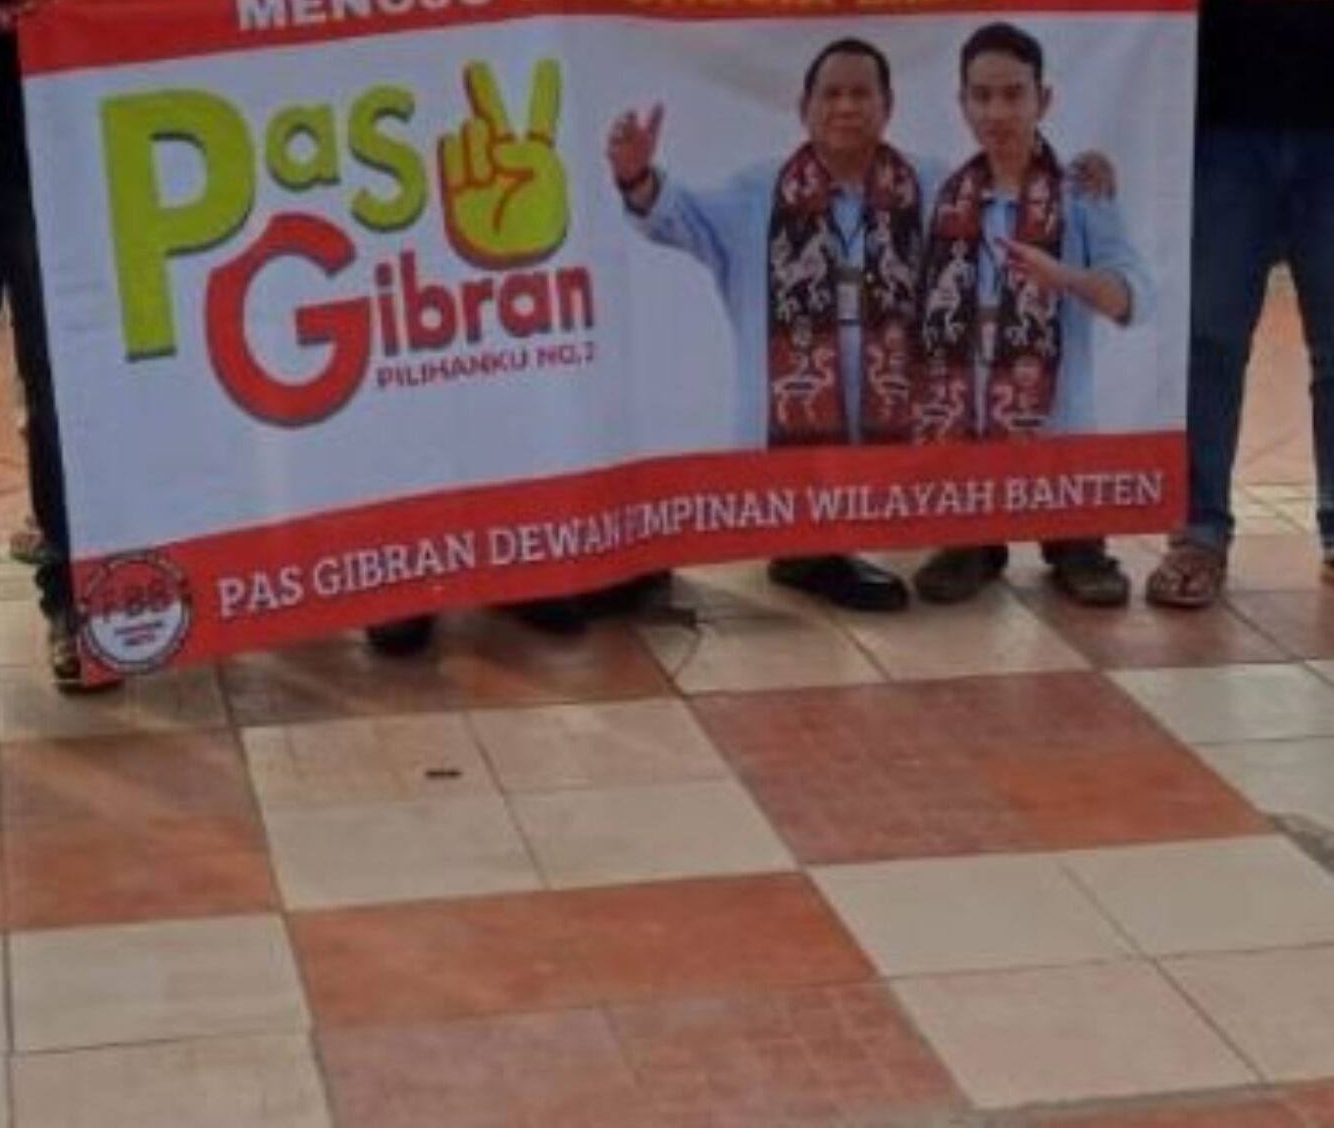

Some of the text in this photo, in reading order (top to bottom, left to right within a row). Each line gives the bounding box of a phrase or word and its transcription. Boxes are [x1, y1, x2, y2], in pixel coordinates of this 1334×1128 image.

[205, 212, 595, 428] Gibran
[376, 349, 528, 388] PILIHANKU
[217, 572, 304, 618] PAS
[313, 530, 477, 592] GIBRAN
[487, 512, 618, 566] DEWAN
[808, 479, 993, 525] WILAYAH
[1003, 472, 1164, 513] BANTEN
